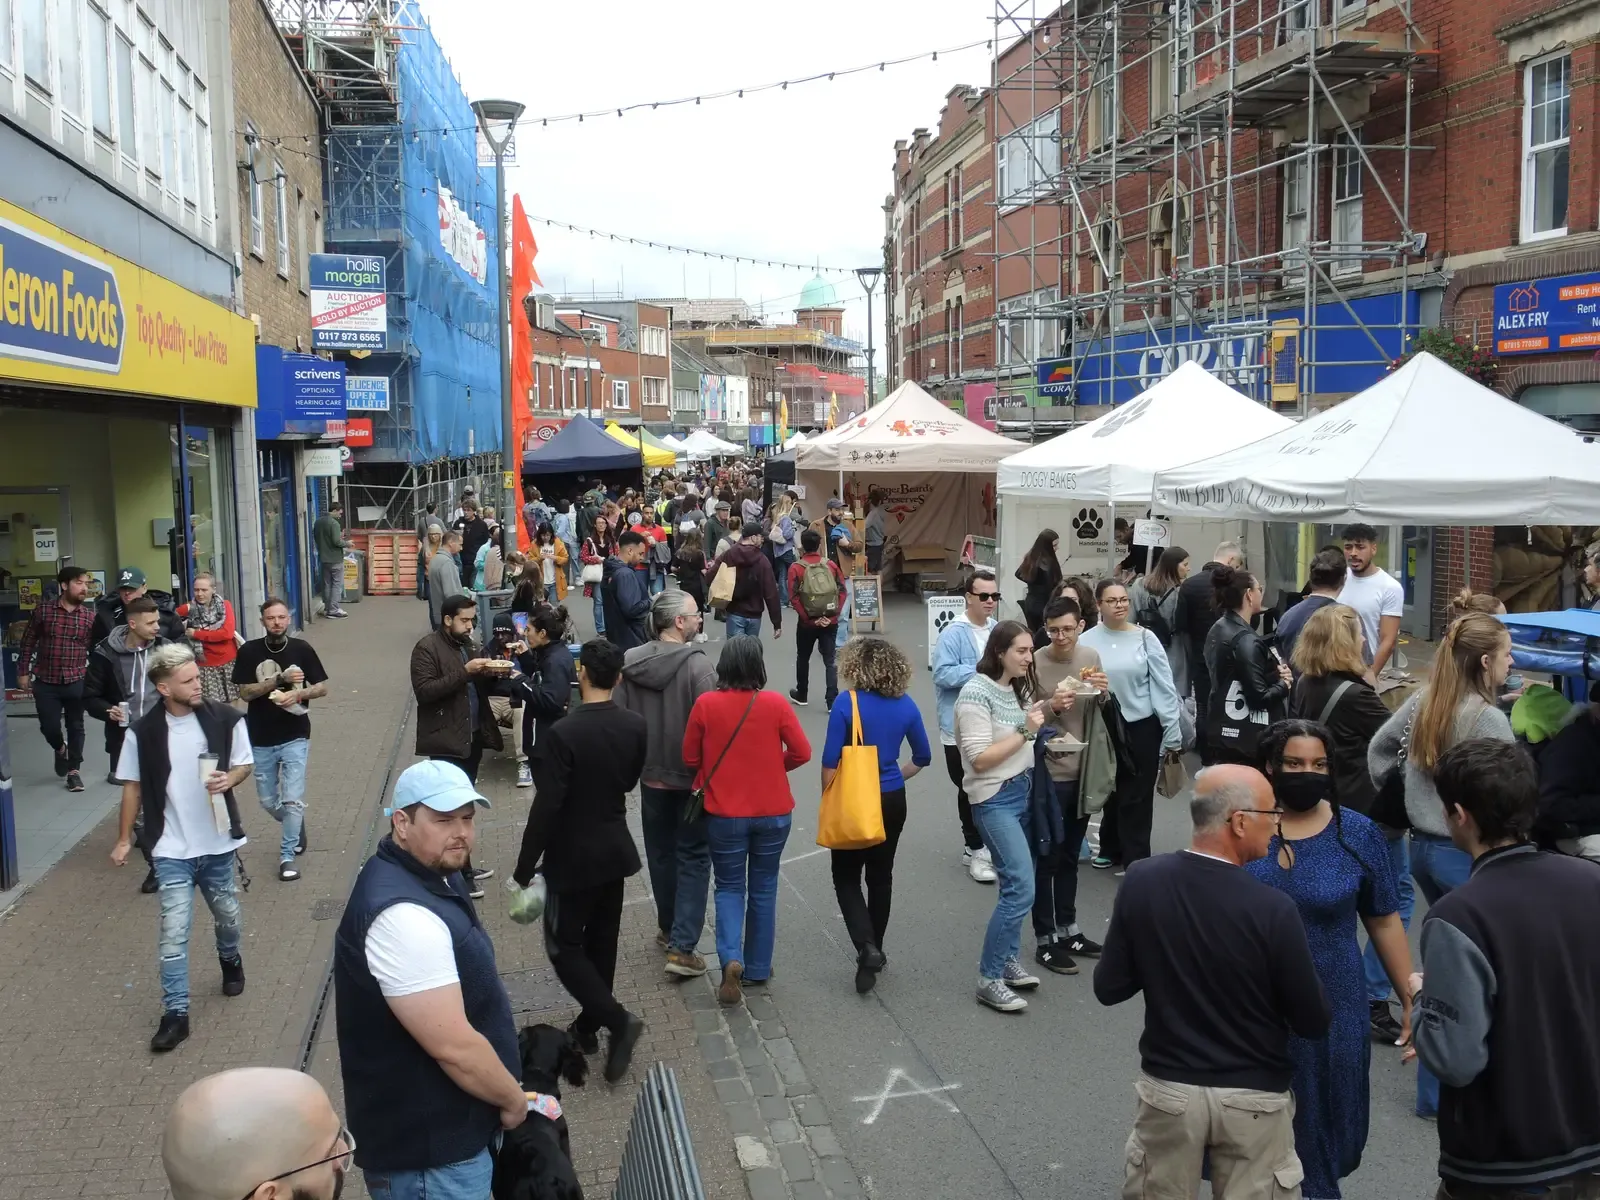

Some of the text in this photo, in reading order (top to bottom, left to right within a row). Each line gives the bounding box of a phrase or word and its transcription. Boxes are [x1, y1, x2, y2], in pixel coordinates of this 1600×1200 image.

[346, 256, 381, 272] hollis
[325, 271, 380, 287] morgan
[0, 243, 118, 349] eron Foods
[1562, 289, 1573, 297] We
[1575, 286, 1590, 297] Buy
[316, 311, 338, 325] SOLD
[338, 306, 350, 318] BY
[349, 296, 383, 314] AUCTION
[1577, 303, 1597, 314] Rent
[1498, 311, 1550, 330] ALEX FRY
[136, 304, 153, 358] Top
[155, 311, 187, 365] Quality
[193, 325, 209, 360] Low
[209, 331, 229, 366] Prices
[318, 331, 381, 343] 0117 973 6565
[316, 341, 384, 350] www.hollismorgan.co.uk
[294, 368, 341, 380] scrivens
[353, 380, 386, 390] LICENCE
[1043, 385, 1077, 393] CORA
[350, 391, 377, 400] OPEN
[363, 400, 387, 409] LATE
[1020, 471, 1077, 490] DOGGY BAKES
[35, 540, 56, 549] OUT
